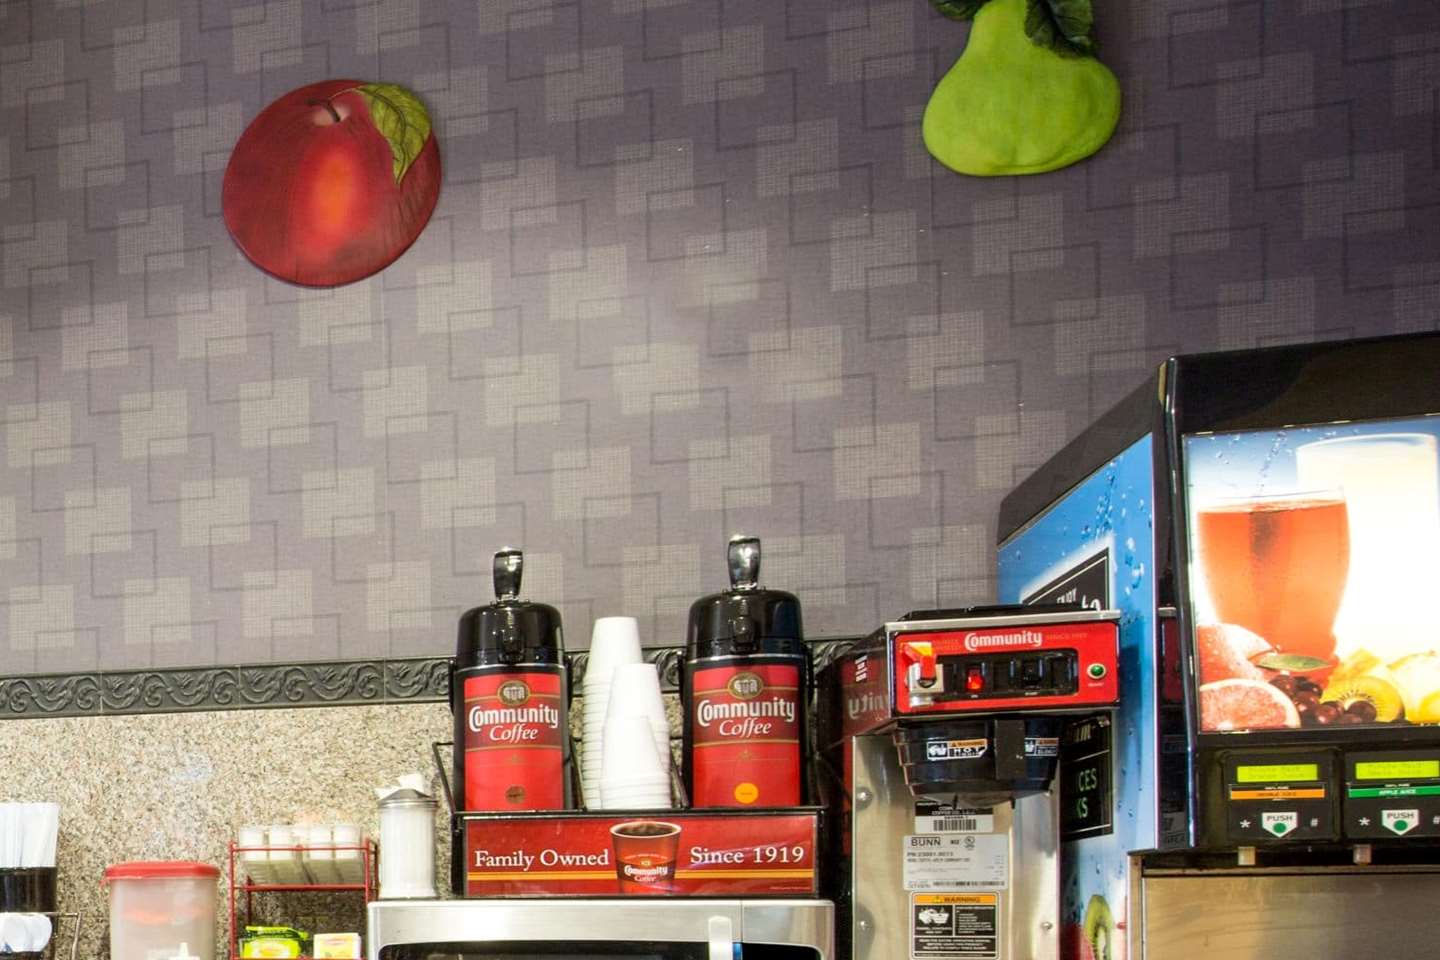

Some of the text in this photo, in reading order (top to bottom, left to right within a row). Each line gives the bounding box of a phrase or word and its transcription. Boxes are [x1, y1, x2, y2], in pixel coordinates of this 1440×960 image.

[964, 630, 1043, 651] Community
[469, 703, 558, 732] Community
[697, 697, 795, 727] Community
[489, 723, 539, 743] Coffee
[719, 717, 772, 738] Coffee
[911, 837, 941, 847] BUNN
[475, 849, 609, 871] Family Owned
[690, 846, 804, 864] Since 1919
[624, 864, 668, 876] Community
